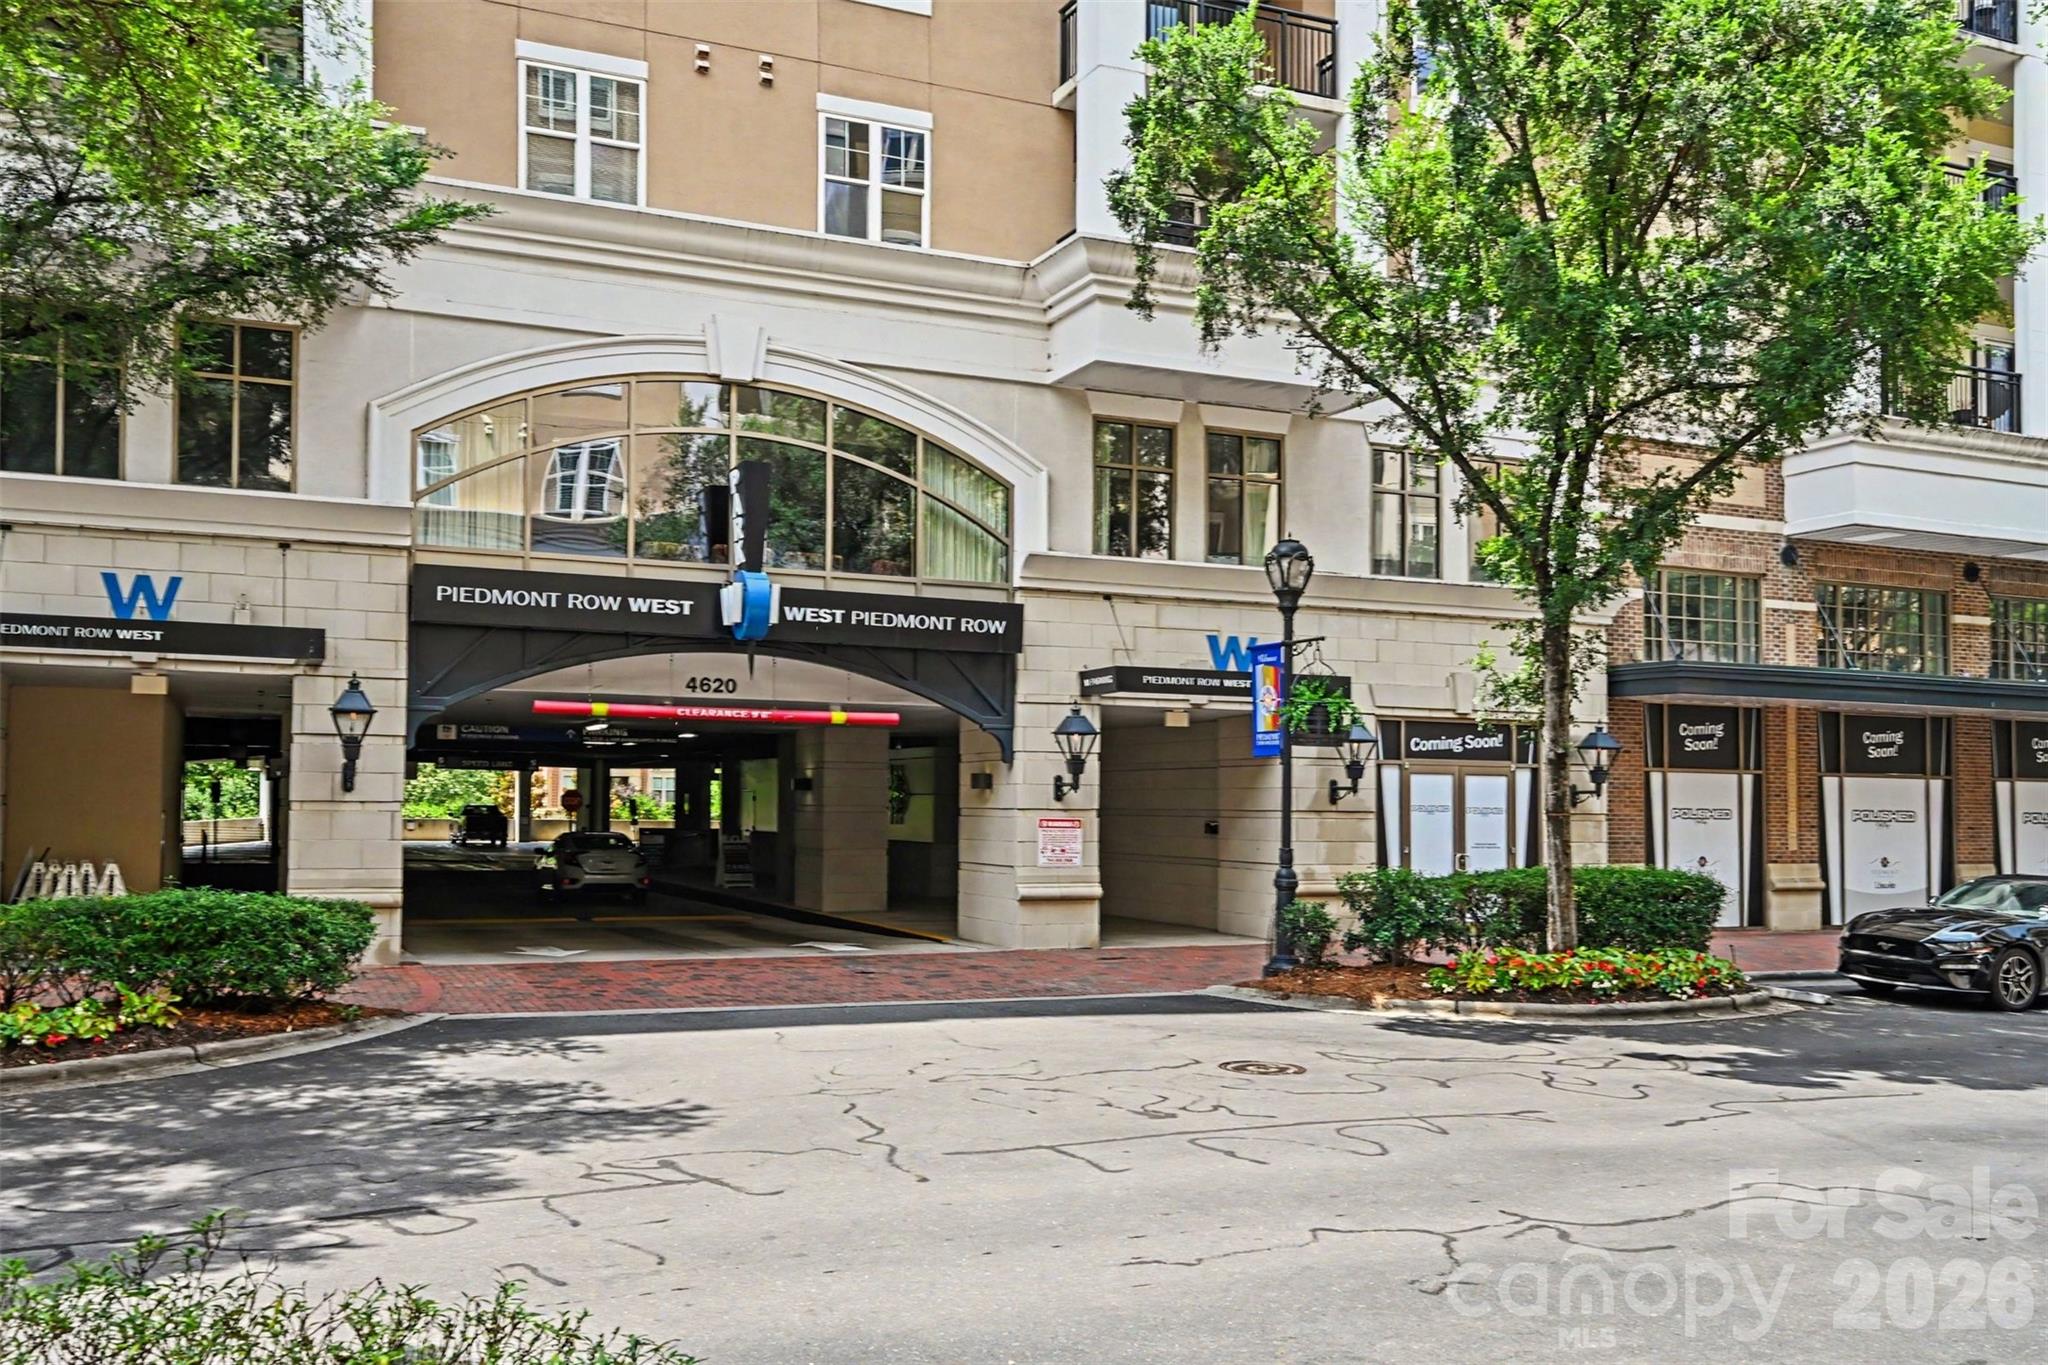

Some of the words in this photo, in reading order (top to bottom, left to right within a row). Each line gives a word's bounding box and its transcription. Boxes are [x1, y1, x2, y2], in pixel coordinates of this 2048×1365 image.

[100, 571, 182, 622] W
[436, 586, 561, 608] PIEDMONT
[567, 593, 622, 611] ROW
[628, 597, 694, 615] WEST
[783, 606, 845, 623] WEST
[851, 610, 956, 631] PIEDMONT
[960, 618, 1007, 634] ROW
[74, 626, 113, 639] ROW
[116, 629, 164, 641] WEST
[685, 677, 737, 694] 4620
[1142, 675, 1195, 686] PIEDMONT
[1197, 677, 1220, 687] ROW
[1222, 679, 1253, 688] WEST
[676, 708, 749, 718] CLEARANCE
[1679, 722, 1725, 737] Coming
[1862, 730, 1904, 744] Coming
[1410, 736, 1464, 752] Coming
[1465, 733, 1504, 748] Soon!
[1684, 737, 1719, 751] Soon!
[1867, 745, 1899, 758] Soon!
[1851, 809, 1917, 823] POLISHED
